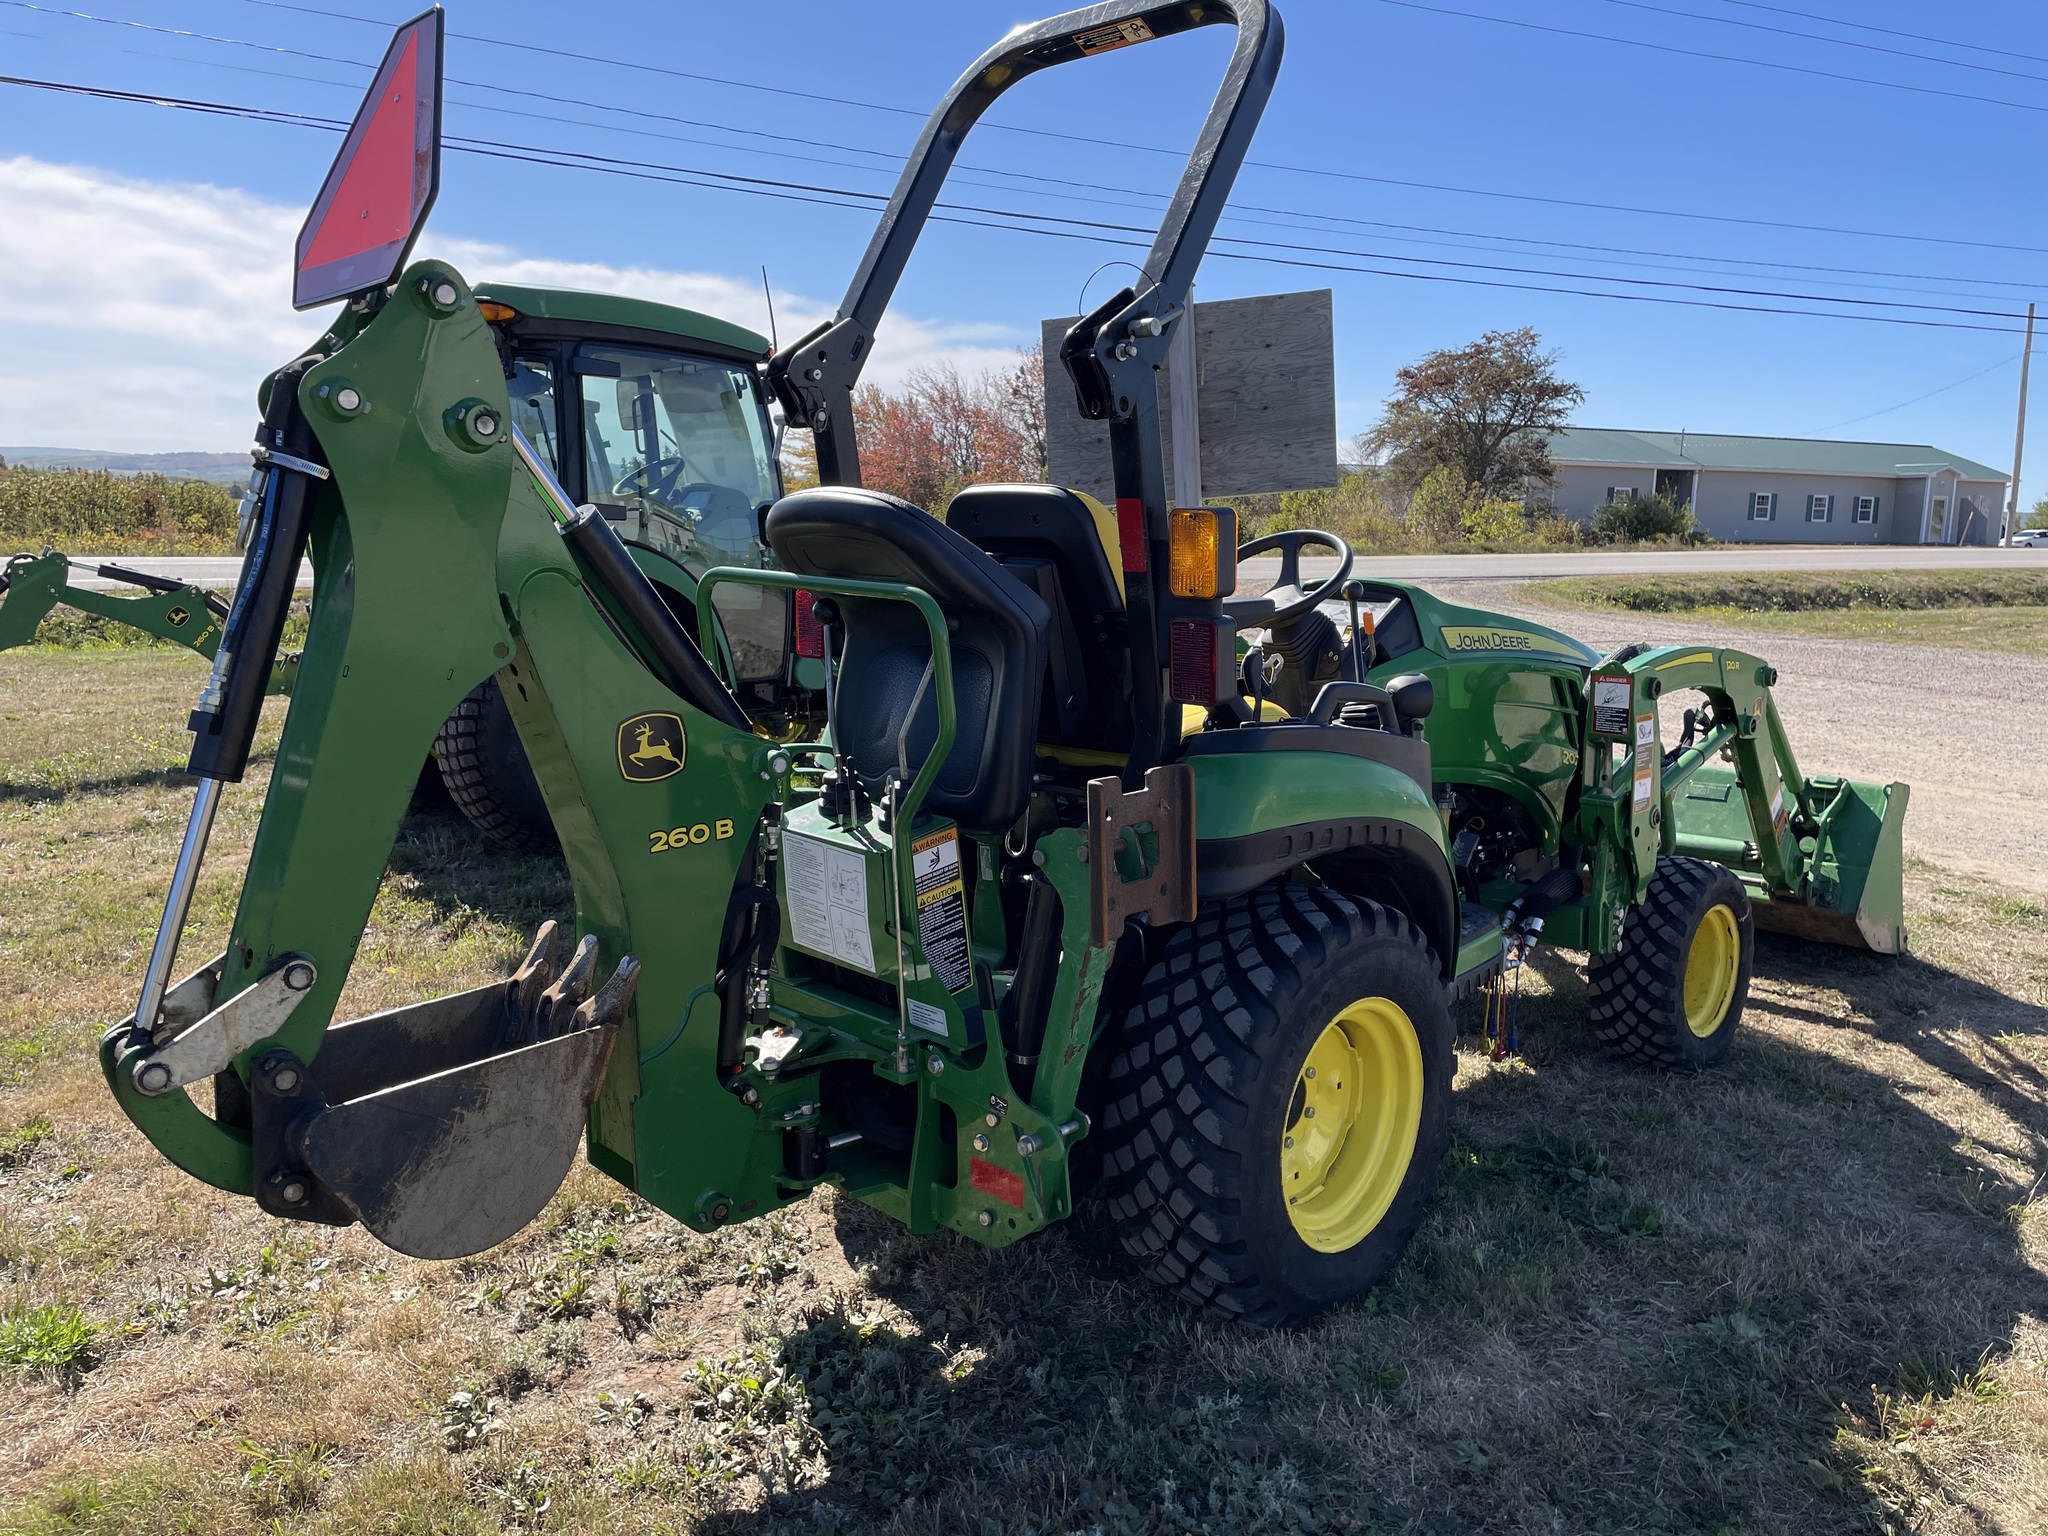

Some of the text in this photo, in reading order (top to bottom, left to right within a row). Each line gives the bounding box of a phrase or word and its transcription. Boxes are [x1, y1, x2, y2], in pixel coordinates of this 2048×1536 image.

[193, 624, 215, 648] 260 B
[1456, 632, 1532, 649] JOHN DEERE
[648, 817, 735, 855] 260 B
[918, 832, 953, 850] WARNING
[925, 885, 957, 904] CAUTION
